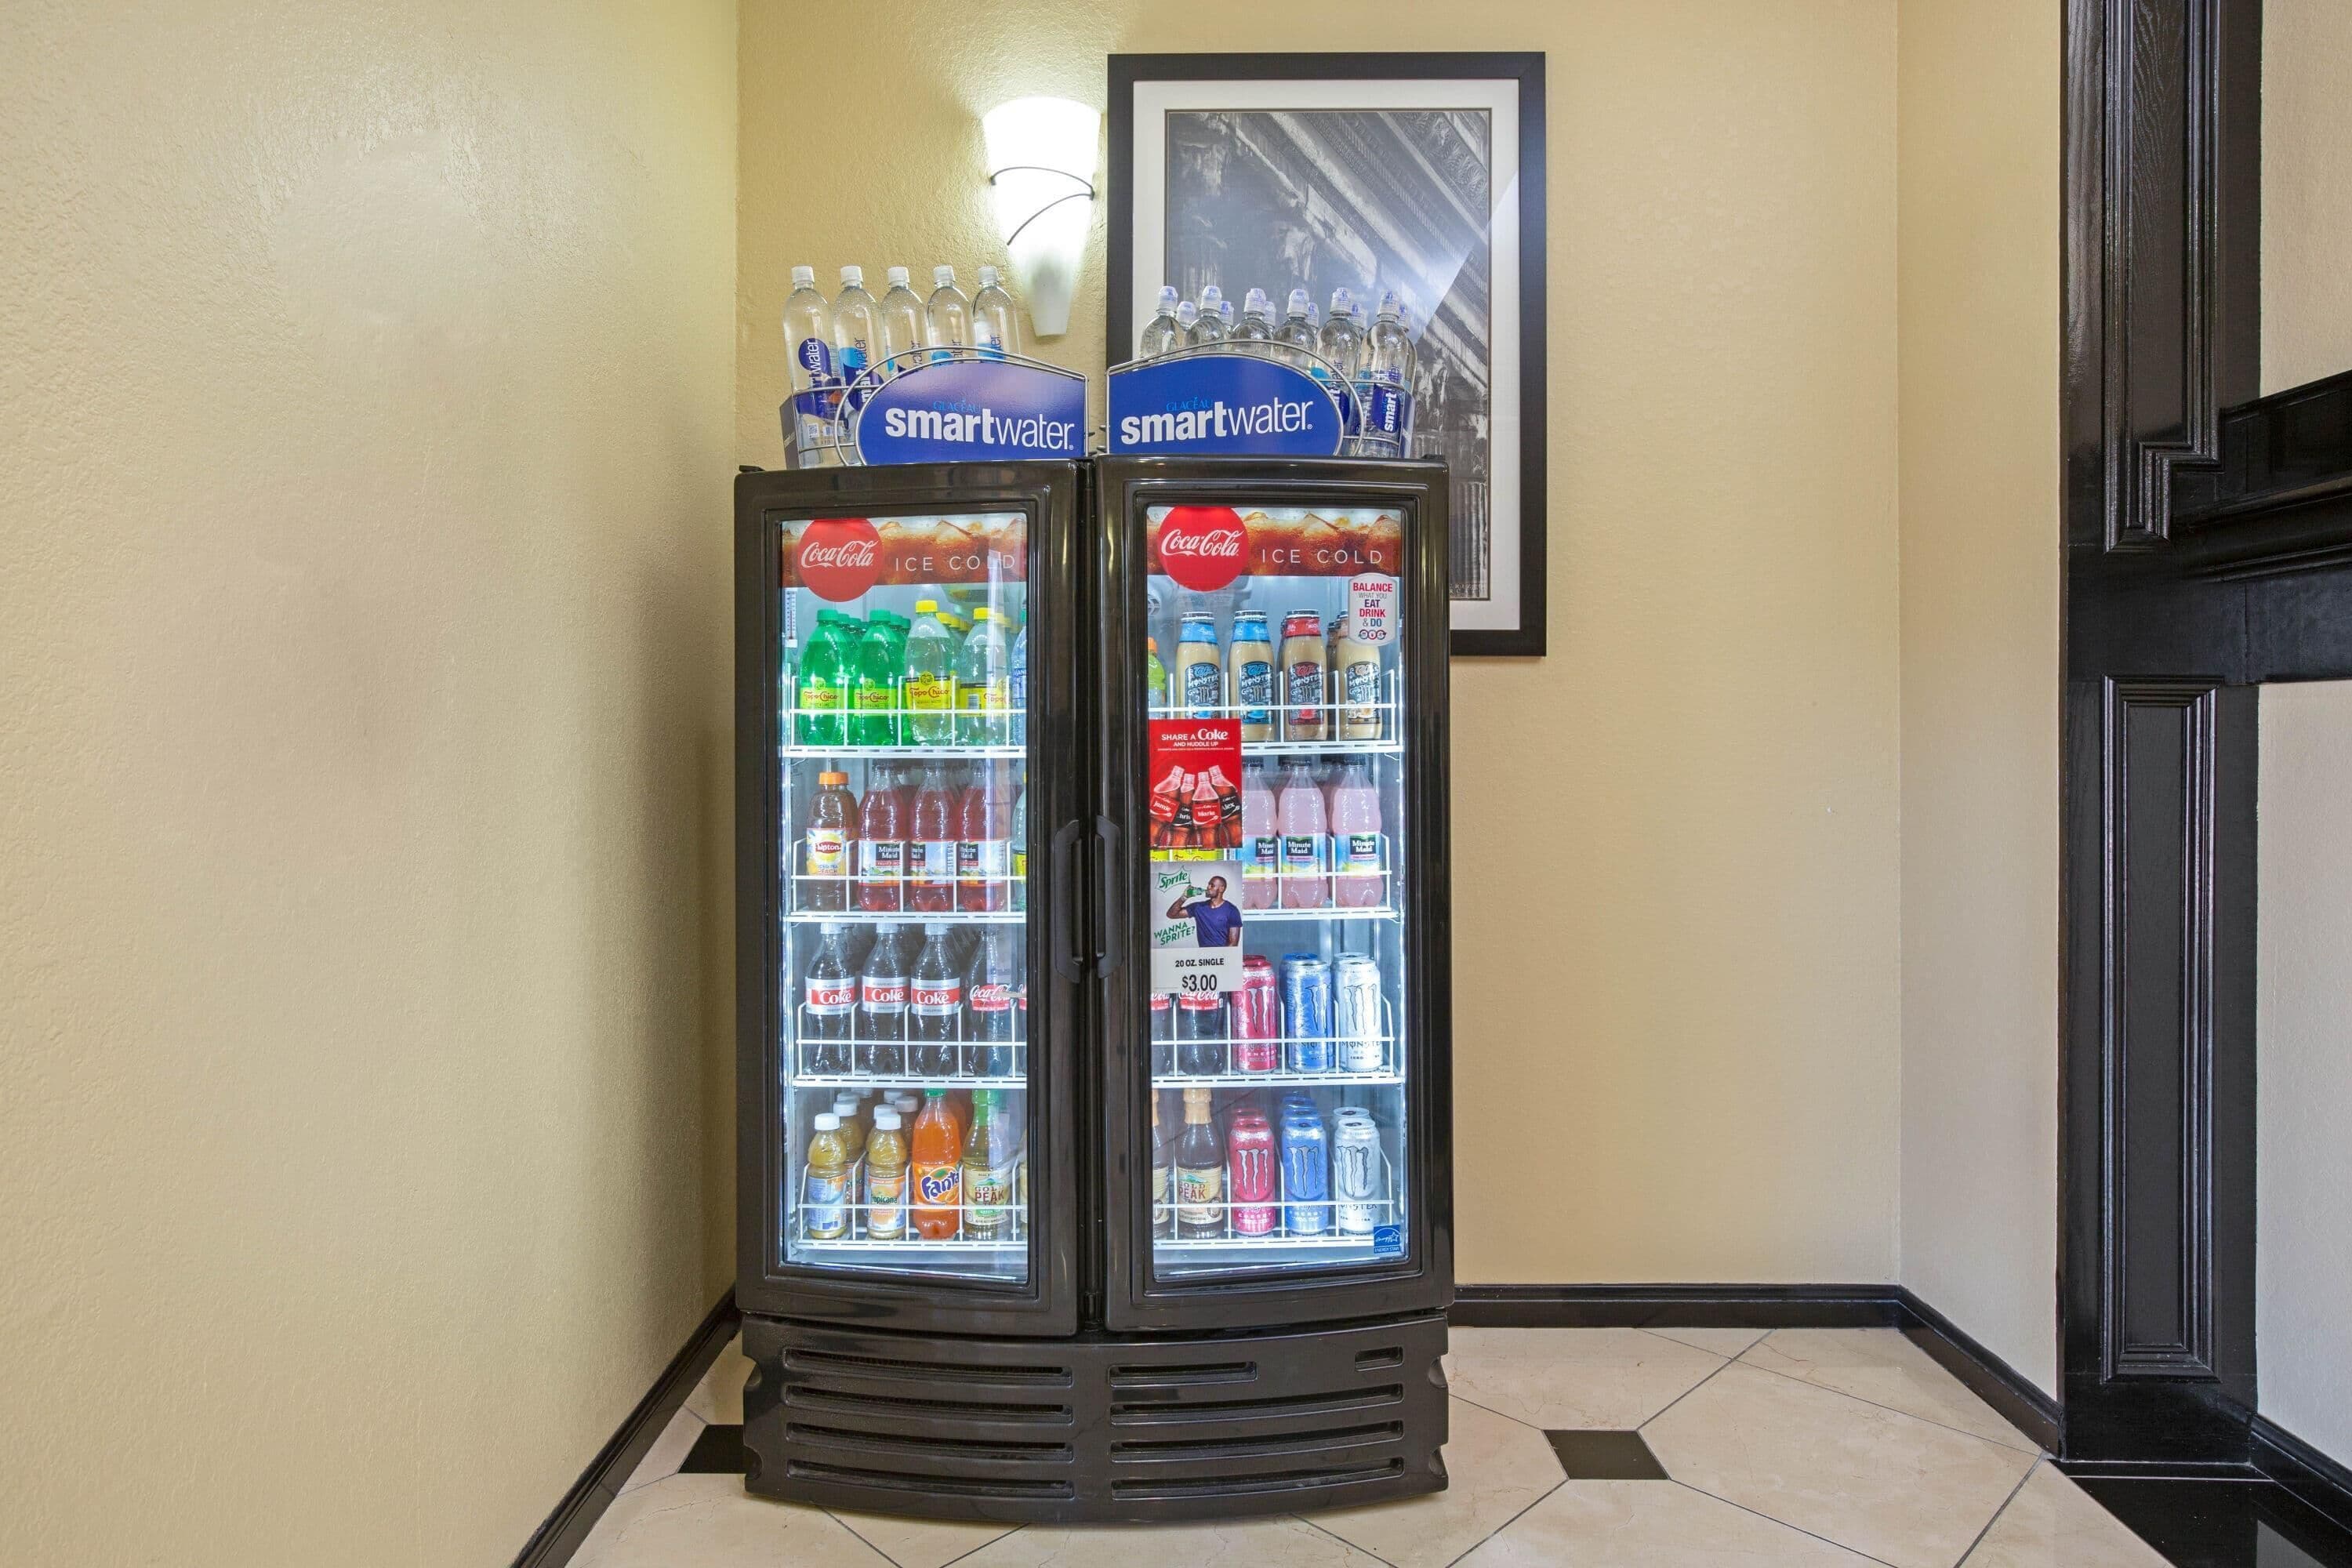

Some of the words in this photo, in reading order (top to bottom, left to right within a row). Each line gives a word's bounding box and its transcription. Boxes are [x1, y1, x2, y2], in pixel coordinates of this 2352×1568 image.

[1161, 529, 1244, 557] Coca-Cola
[801, 540, 879, 568] Coca-Cola
[1262, 549, 1301, 563] ICE
[1317, 550, 1383, 564] COLD
[895, 557, 934, 572] ICE
[949, 555, 1014, 571] COLD
[1352, 583, 1393, 592] BALANCE
[1364, 599, 1380, 608] EAT
[1359, 608, 1385, 617] DRINK
[1363, 619, 1368, 627] &
[1197, 728, 1229, 740] Coke
[1160, 871, 1188, 888] Sprite
[1154, 921, 1188, 939] WANNA
[1160, 926, 1196, 946] SPRITE?
[1181, 975, 1217, 992] $3.00
[819, 990, 851, 1004] Coke
[871, 988, 904, 1002] Coke
[916, 990, 949, 1004] Coke
[975, 1190, 1004, 1202] PEAK
[1178, 1187, 1206, 1199] PEAK
